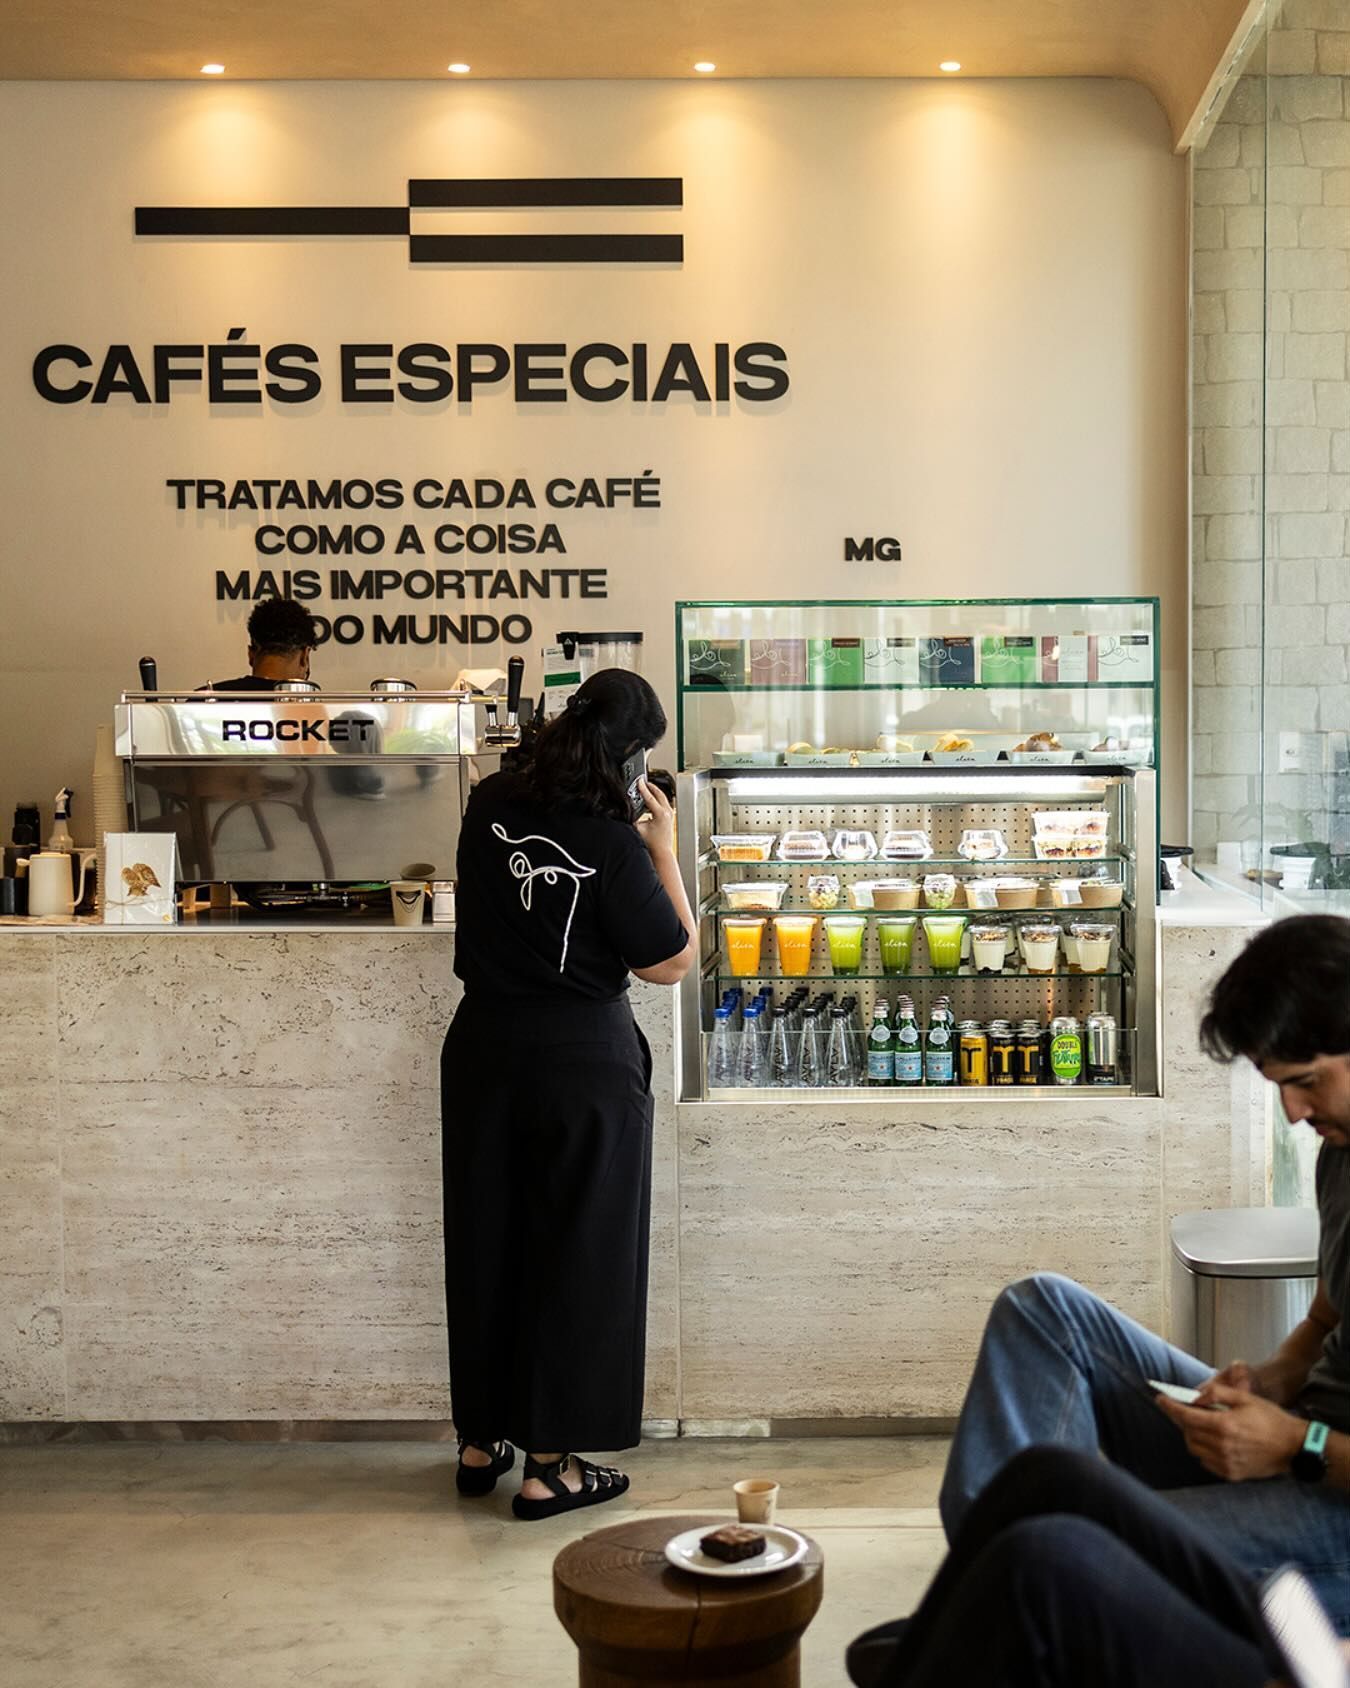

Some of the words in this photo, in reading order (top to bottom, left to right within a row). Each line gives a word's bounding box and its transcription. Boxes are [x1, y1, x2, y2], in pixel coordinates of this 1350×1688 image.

[32, 327, 321, 404] CAFÉS
[340, 342, 790, 404] ESPECIAIS
[166, 478, 404, 510] TRATAMOS
[413, 478, 537, 509] CADA
[545, 469, 661, 509] CAFÉ
[254, 524, 386, 555] COMO
[394, 524, 426, 555] A
[434, 523, 567, 555] COISA
[844, 537, 902, 562] MG
[216, 569, 322, 600] MAIS
[329, 568, 608, 600] IMPORTANTE
[373, 614, 533, 645] MUNDO
[221, 719, 375, 742] ROCKET
